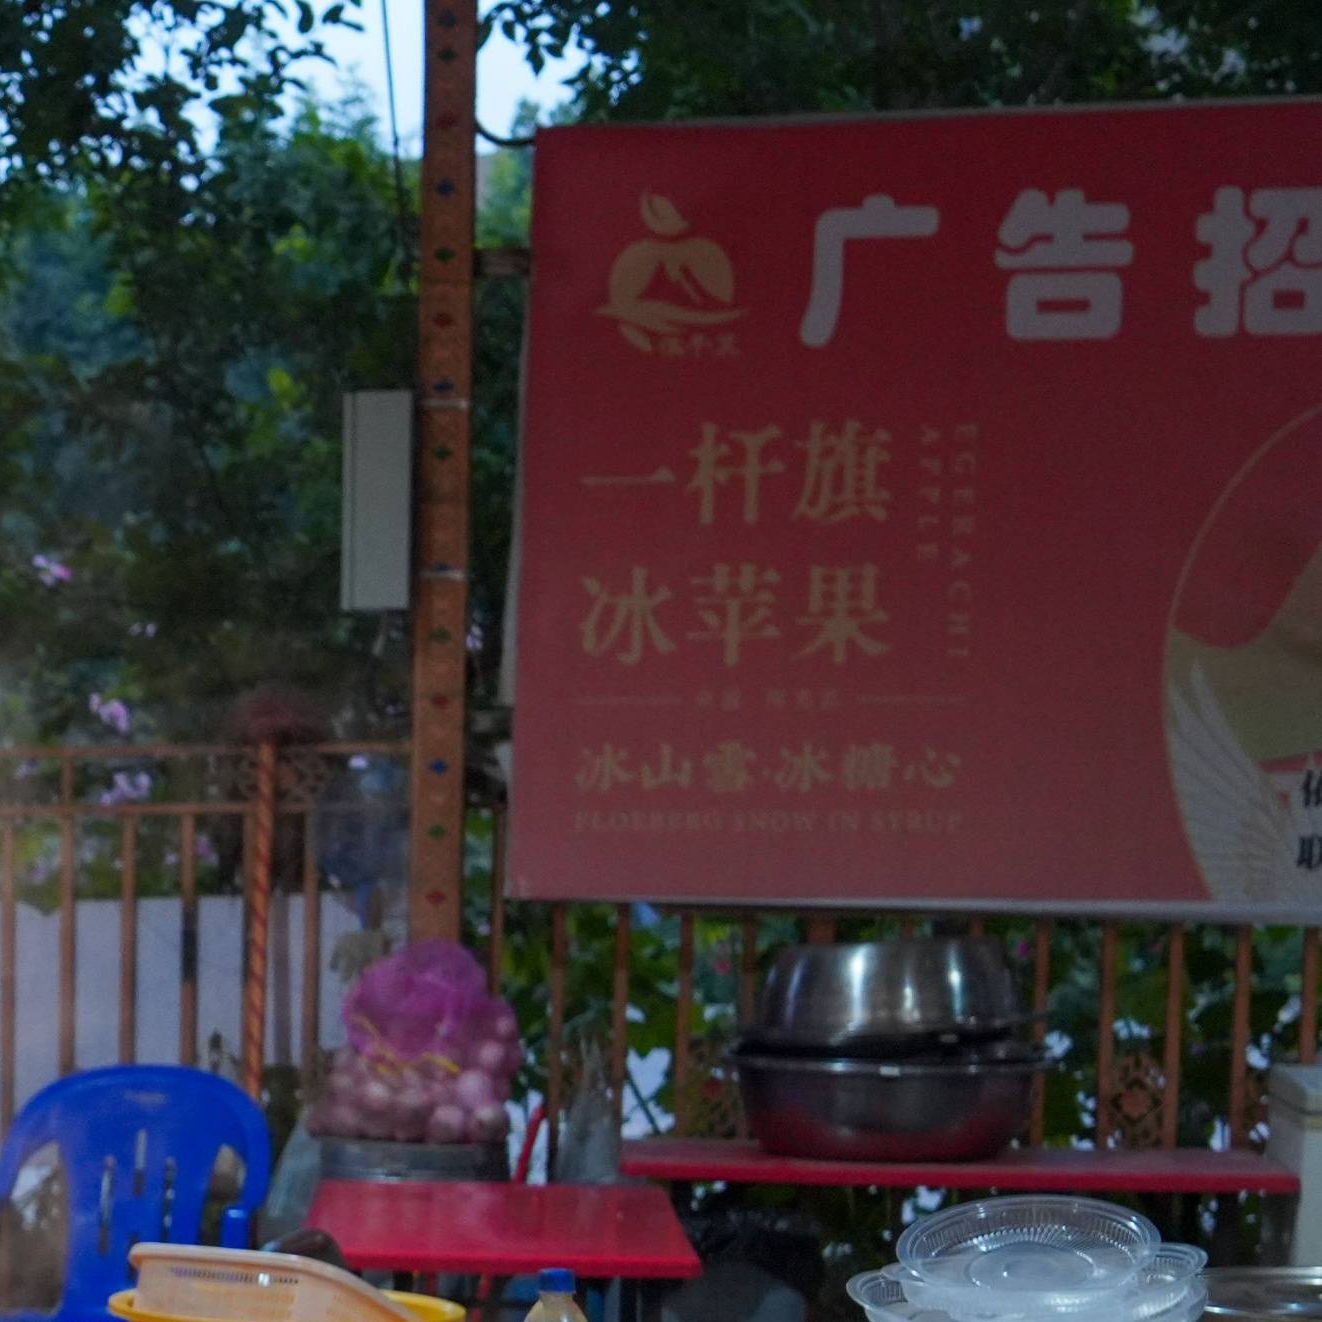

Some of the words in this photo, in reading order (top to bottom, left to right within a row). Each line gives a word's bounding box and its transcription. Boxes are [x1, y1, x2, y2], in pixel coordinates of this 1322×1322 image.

[579, 420, 894, 524] 一杆旗
[579, 563, 894, 667] 冰苹果
